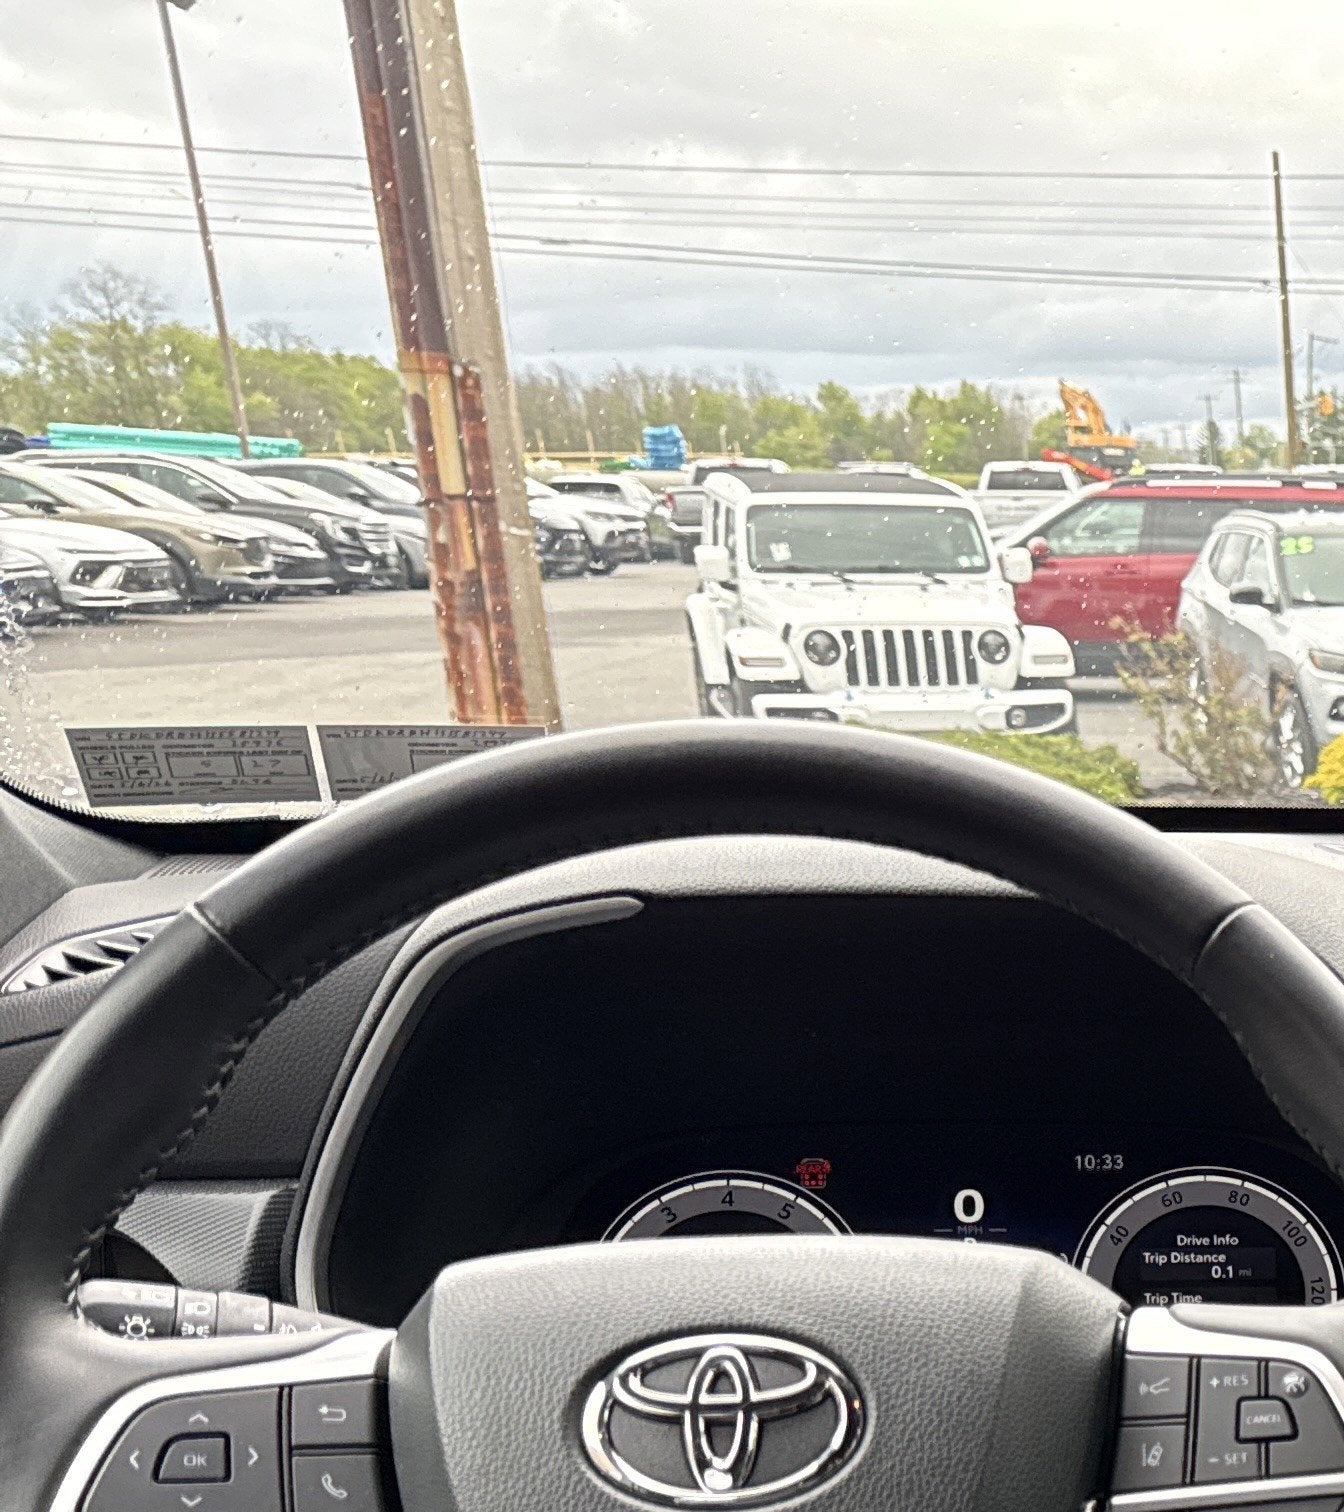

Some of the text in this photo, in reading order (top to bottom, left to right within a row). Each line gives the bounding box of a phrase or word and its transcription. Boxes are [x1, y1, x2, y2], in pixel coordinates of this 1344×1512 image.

[1074, 1154, 1125, 1172] 10:33
[720, 1190, 735, 1207] 4
[953, 1188, 985, 1224] 0
[1161, 1190, 1184, 1208] 60
[1228, 1190, 1250, 1207] 80
[659, 1206, 679, 1224] 3
[777, 1202, 796, 1220] 5
[957, 1226, 983, 1235] MPH
[1109, 1225, 1129, 1248] 40
[1282, 1219, 1308, 1248] 100
[1176, 1233, 1239, 1246] Drive Info
[1143, 1251, 1227, 1265] Trip Distance
[1211, 1266, 1252, 1279] 0.1 mi
[1144, 1292, 1203, 1306] Trip Time
[1310, 1276, 1325, 1305] 120
[1246, 1413, 1282, 1425] CANCEL
[183, 1454, 208, 1467] OK
